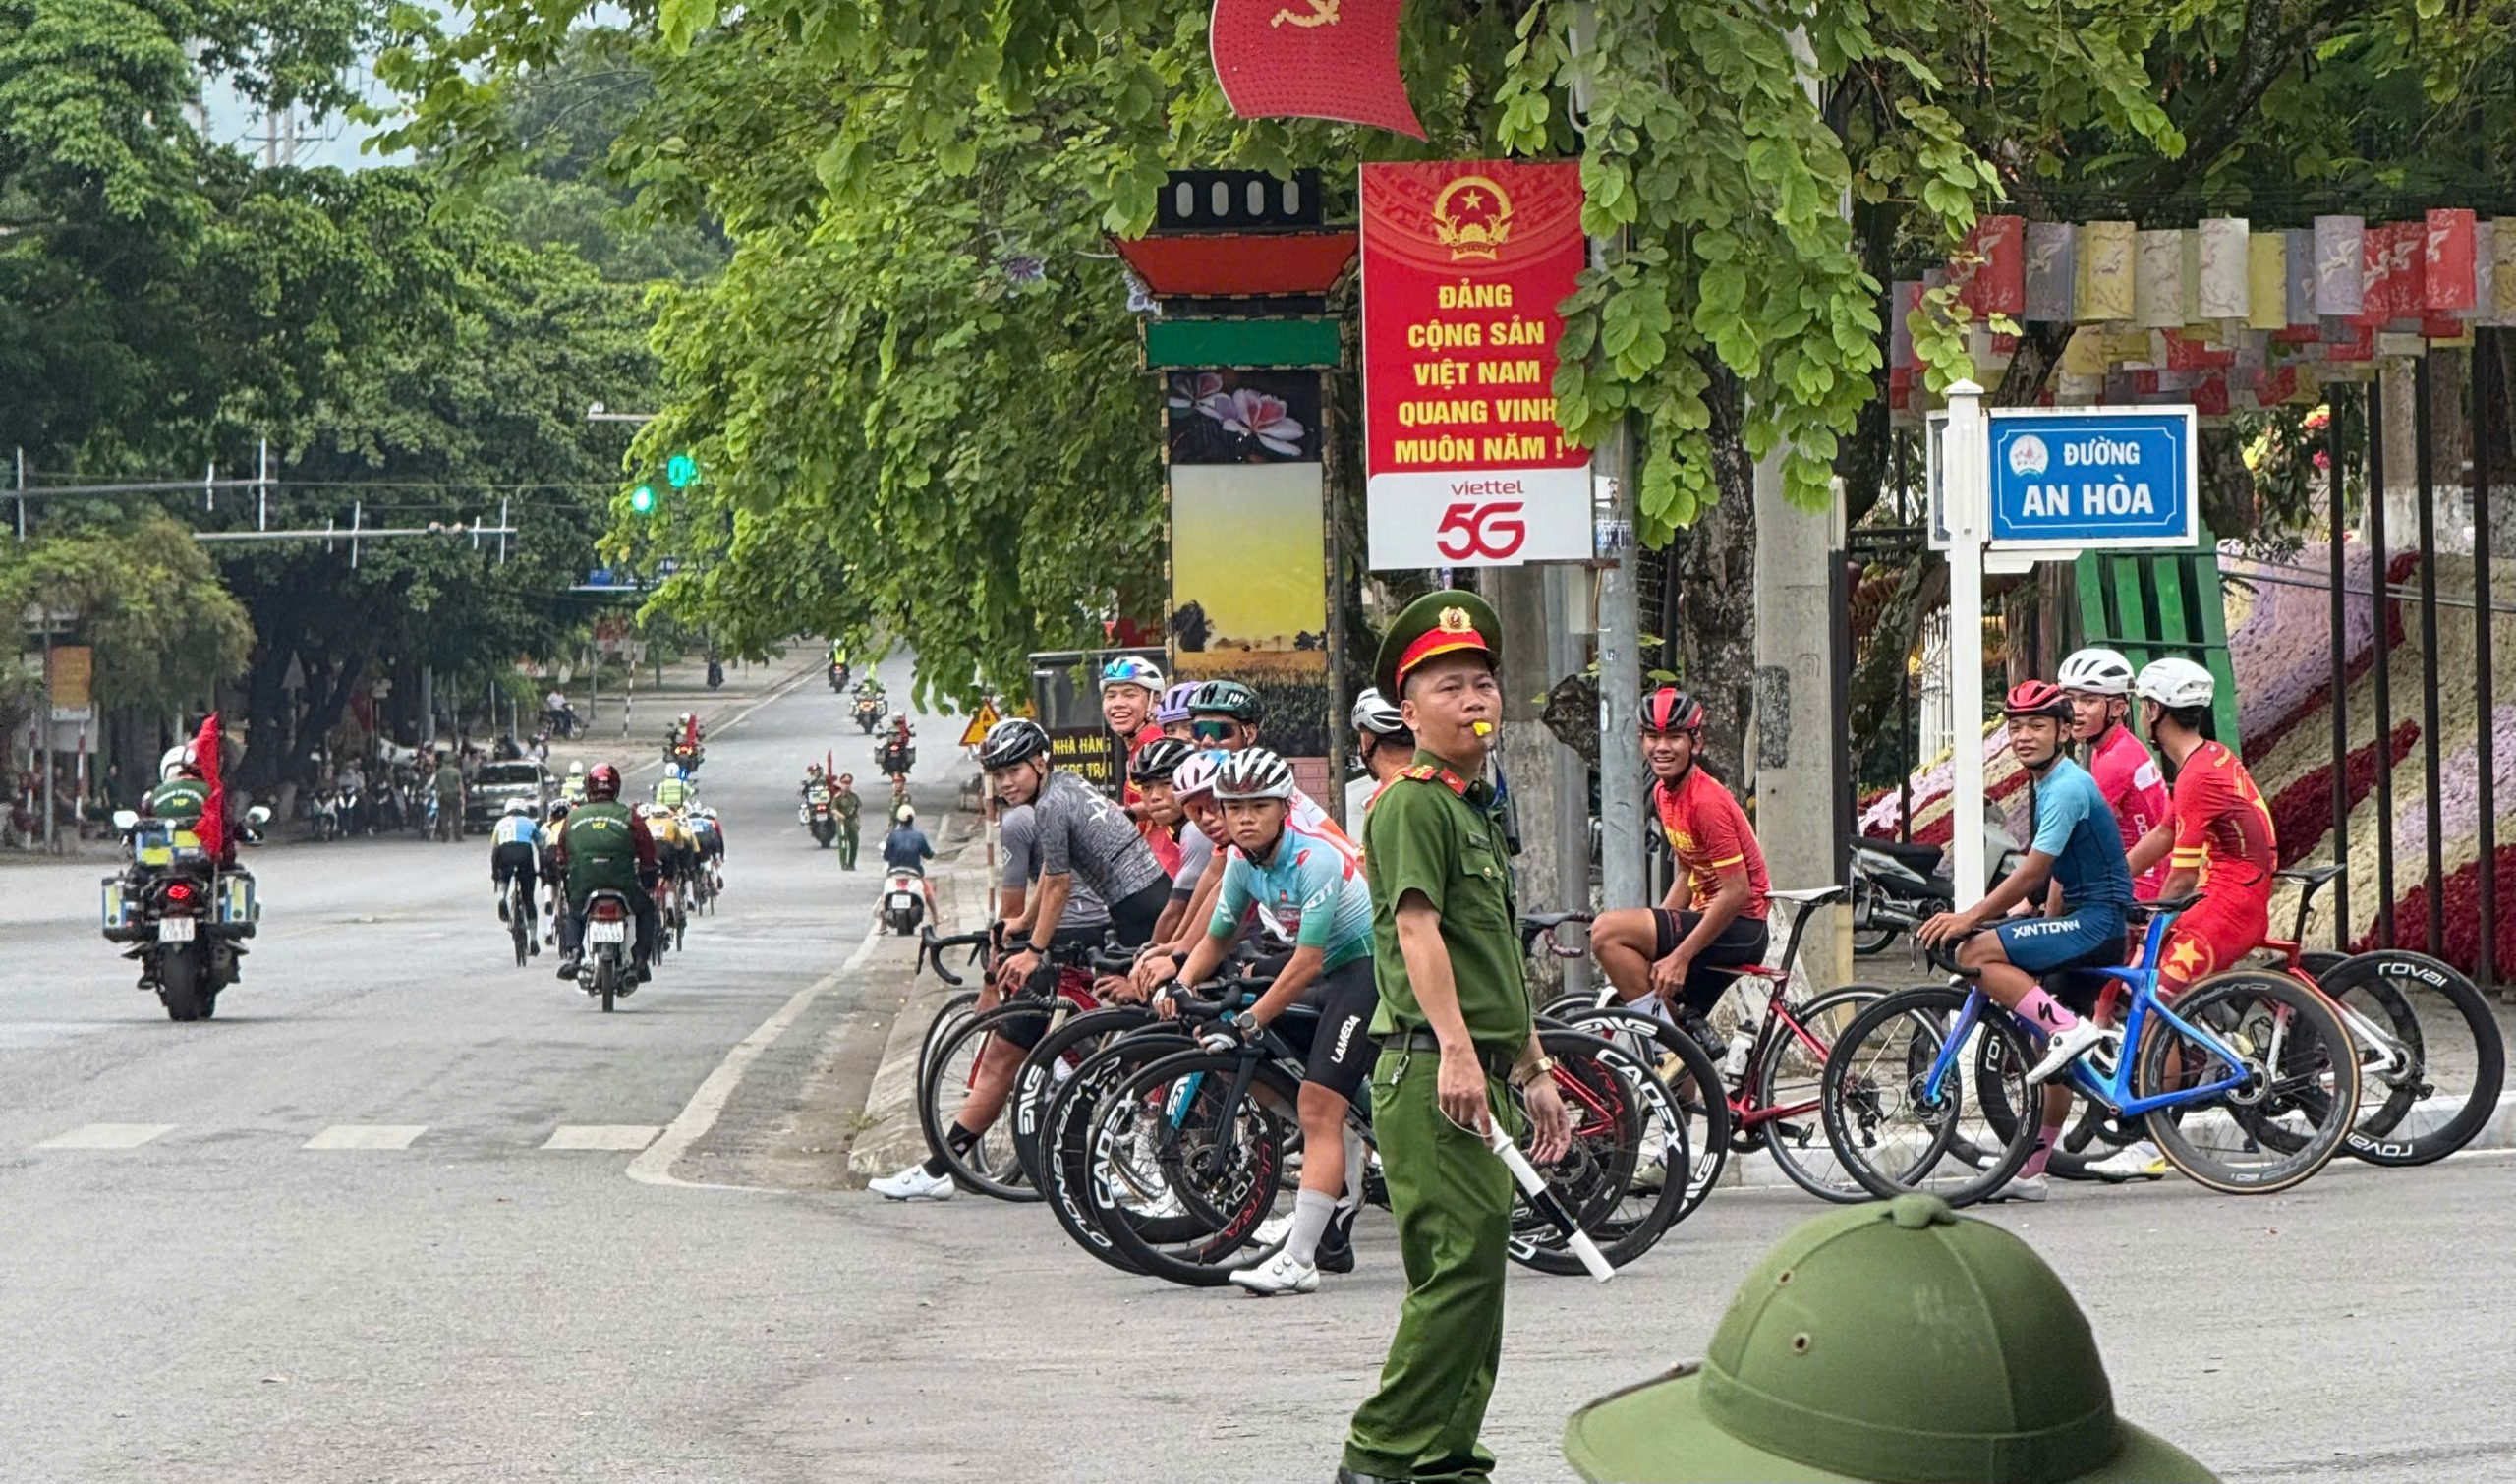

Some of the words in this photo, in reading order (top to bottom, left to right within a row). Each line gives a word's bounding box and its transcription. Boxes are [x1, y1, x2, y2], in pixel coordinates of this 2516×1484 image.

[1438, 278, 1513, 308] ĐẢNG
[1408, 320, 1481, 352] CỘNG
[1490, 316, 1544, 346] SẢN
[1413, 357, 1470, 390] VIỆT
[1477, 360, 1541, 385] NAM
[1398, 400, 1488, 427] QUANG
[1495, 398, 1559, 423] VINH
[1394, 436, 1475, 464] MUÔN
[1483, 435, 1546, 461] NĂM
[2064, 436, 2141, 466] ĐƯỜNG
[1451, 480, 1524, 496] viettel
[2022, 485, 2070, 517] AN
[2082, 474, 2154, 515] HÒA
[1436, 502, 1526, 560] 5G
[1053, 735, 1076, 755] NHÀ
[2378, 962, 2448, 987] roval
[1331, 1015, 1361, 1064] LAMEDA
[1596, 1049, 1683, 1155] CADEX
[1093, 1087, 1137, 1210] CADEX
[2346, 1131, 2414, 1158] roval
